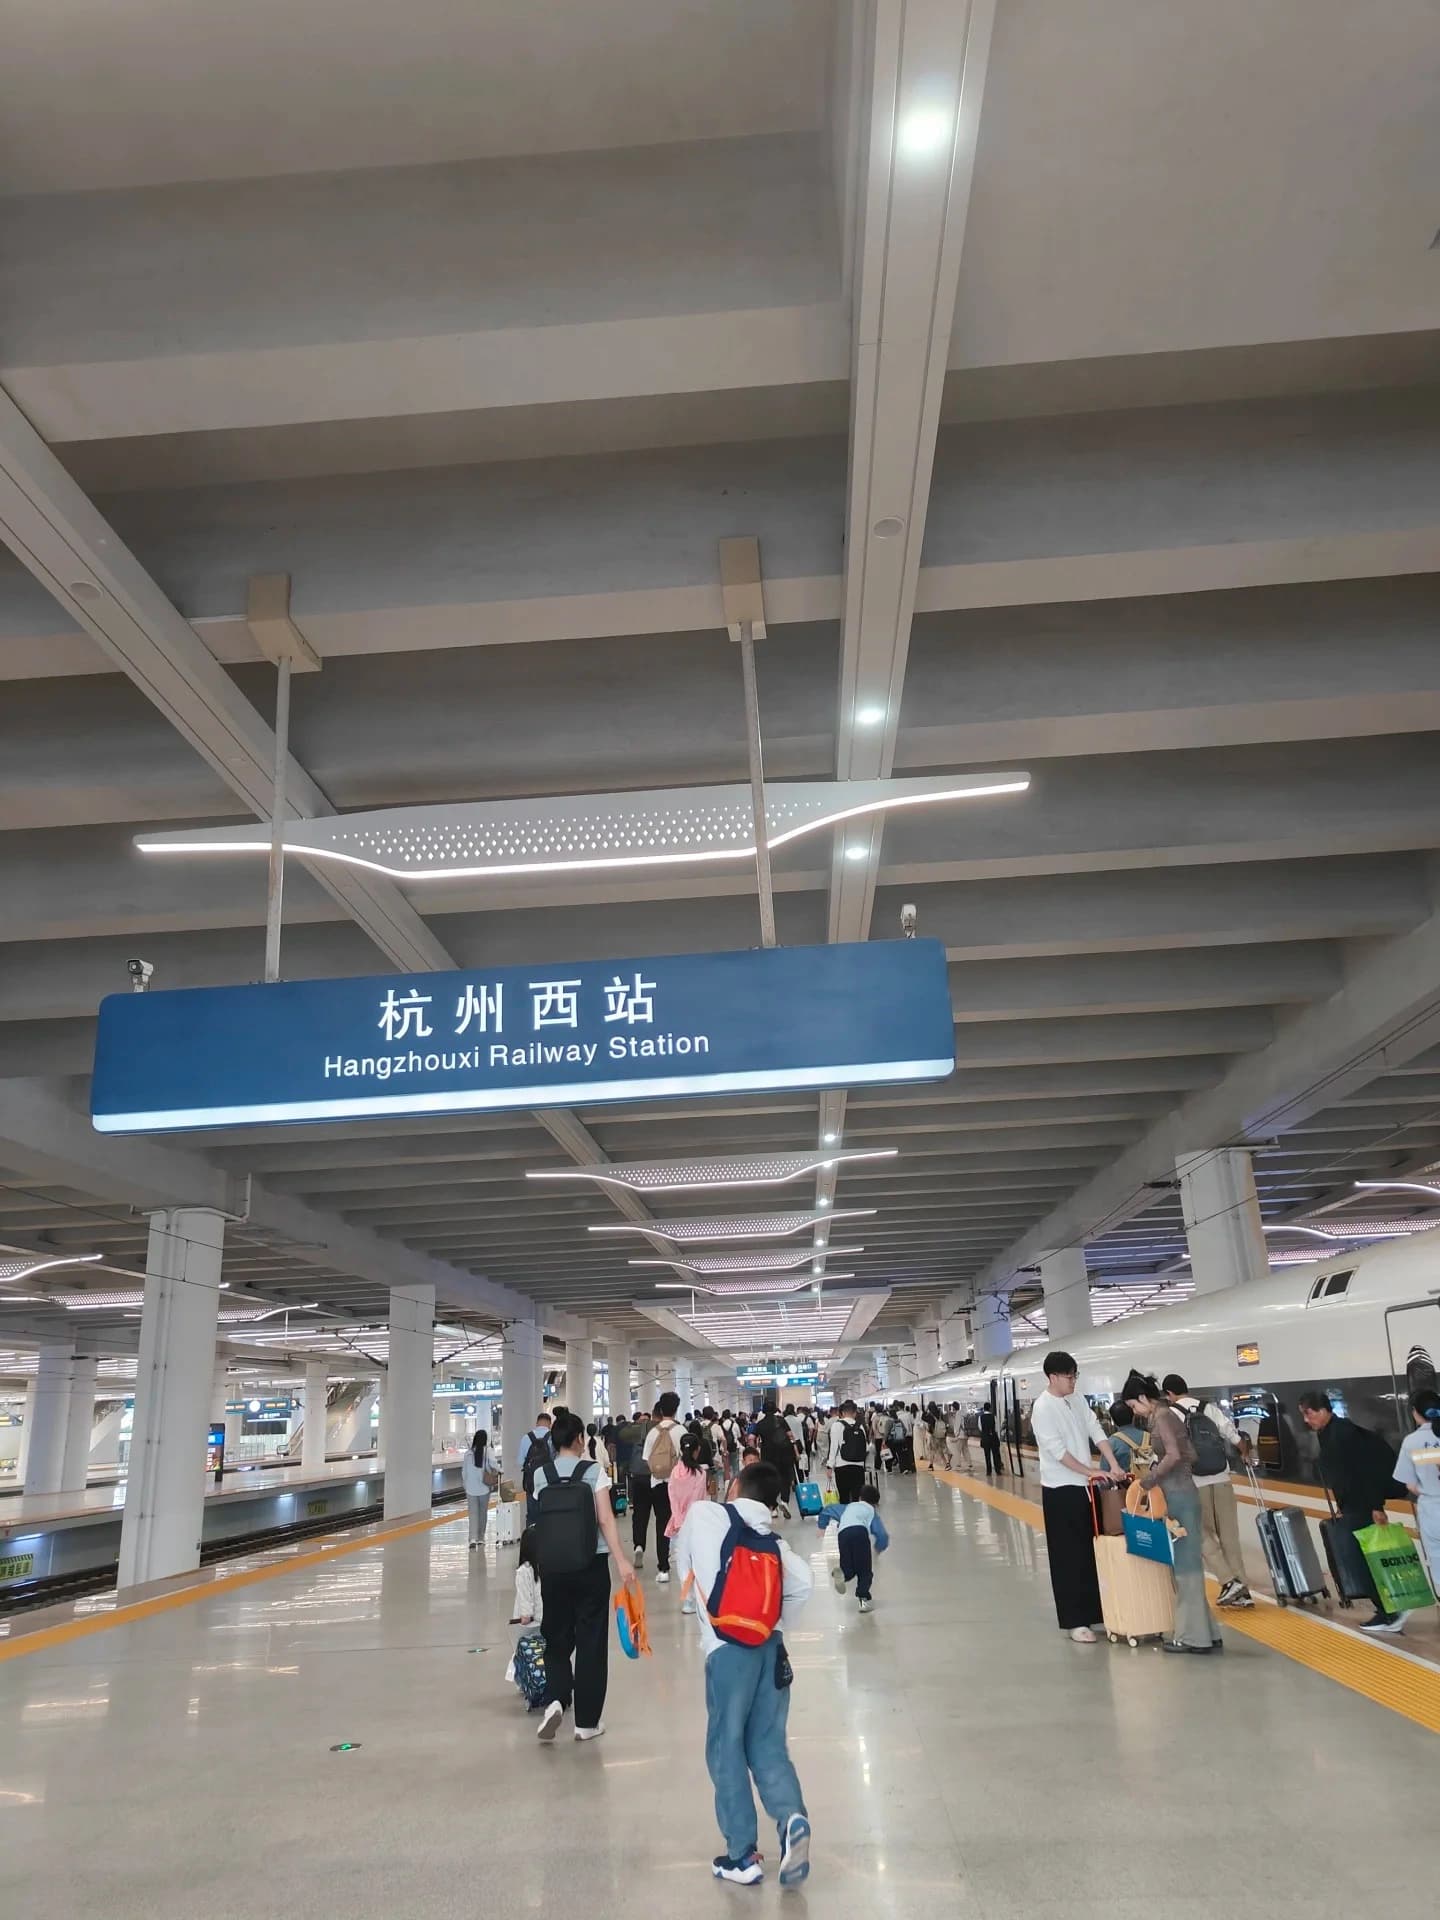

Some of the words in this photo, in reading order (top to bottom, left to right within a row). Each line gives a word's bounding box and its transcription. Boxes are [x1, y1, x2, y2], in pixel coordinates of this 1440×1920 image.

[378, 972, 657, 1041] 杭州西站
[323, 1046, 481, 1081] Hangzhouxi
[489, 1042, 597, 1067] Railway
[608, 1033, 710, 1059] Station
